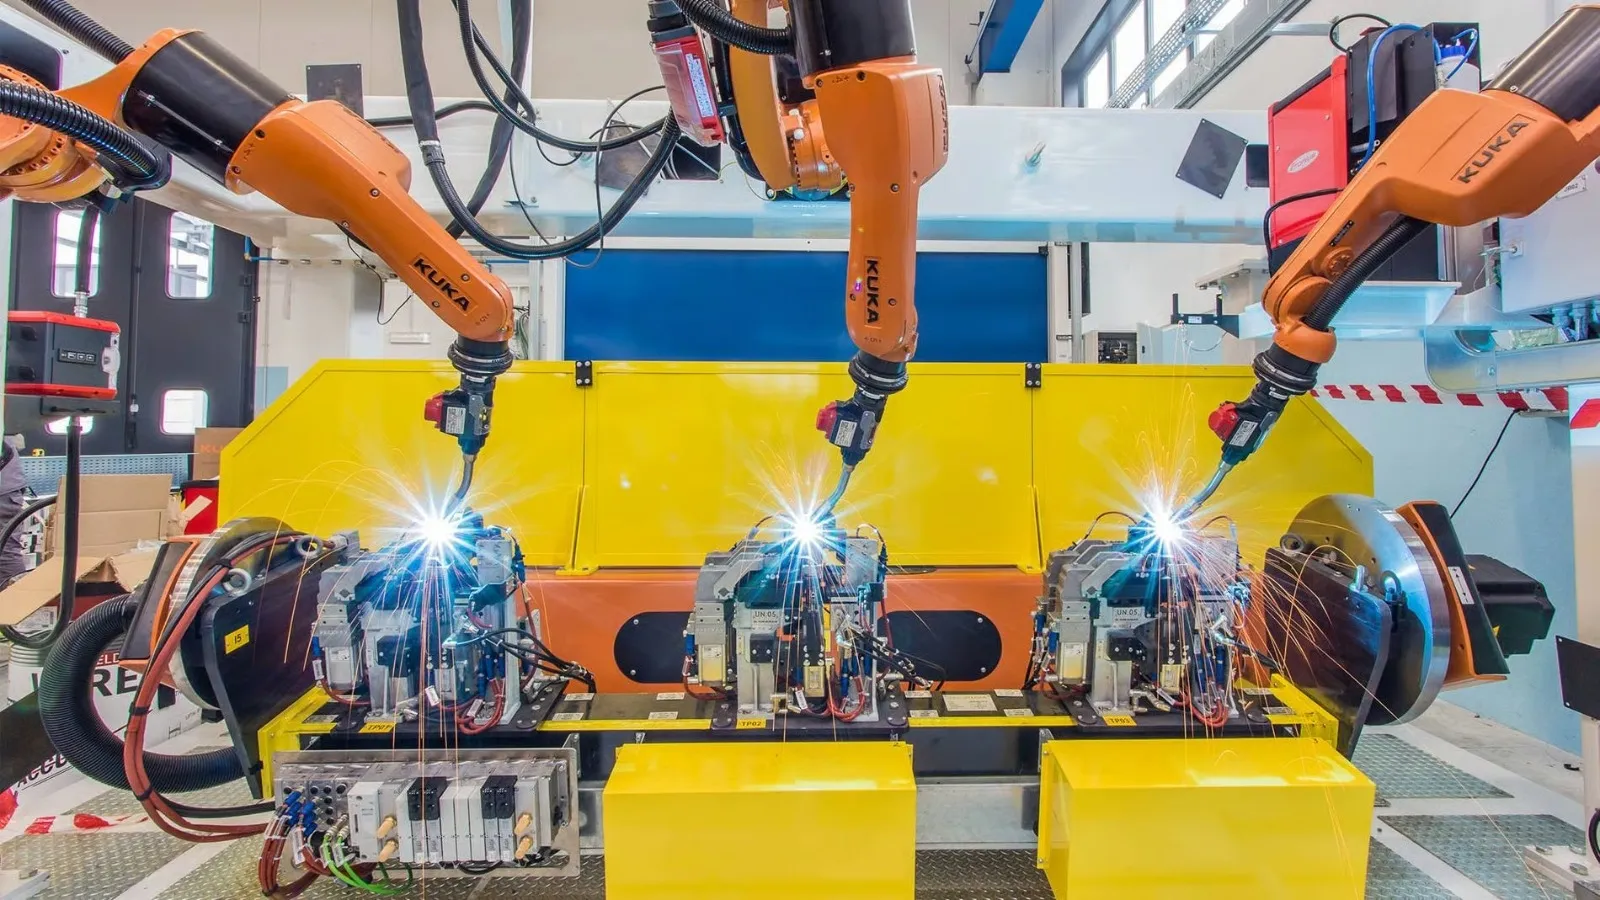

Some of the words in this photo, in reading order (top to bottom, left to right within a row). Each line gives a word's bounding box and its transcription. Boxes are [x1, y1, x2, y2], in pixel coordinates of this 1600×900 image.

[1457, 122, 1529, 184] KUKA
[413, 258, 470, 312] KUKA
[866, 259, 880, 324] KUKA
[234, 633, 242, 645] 15
